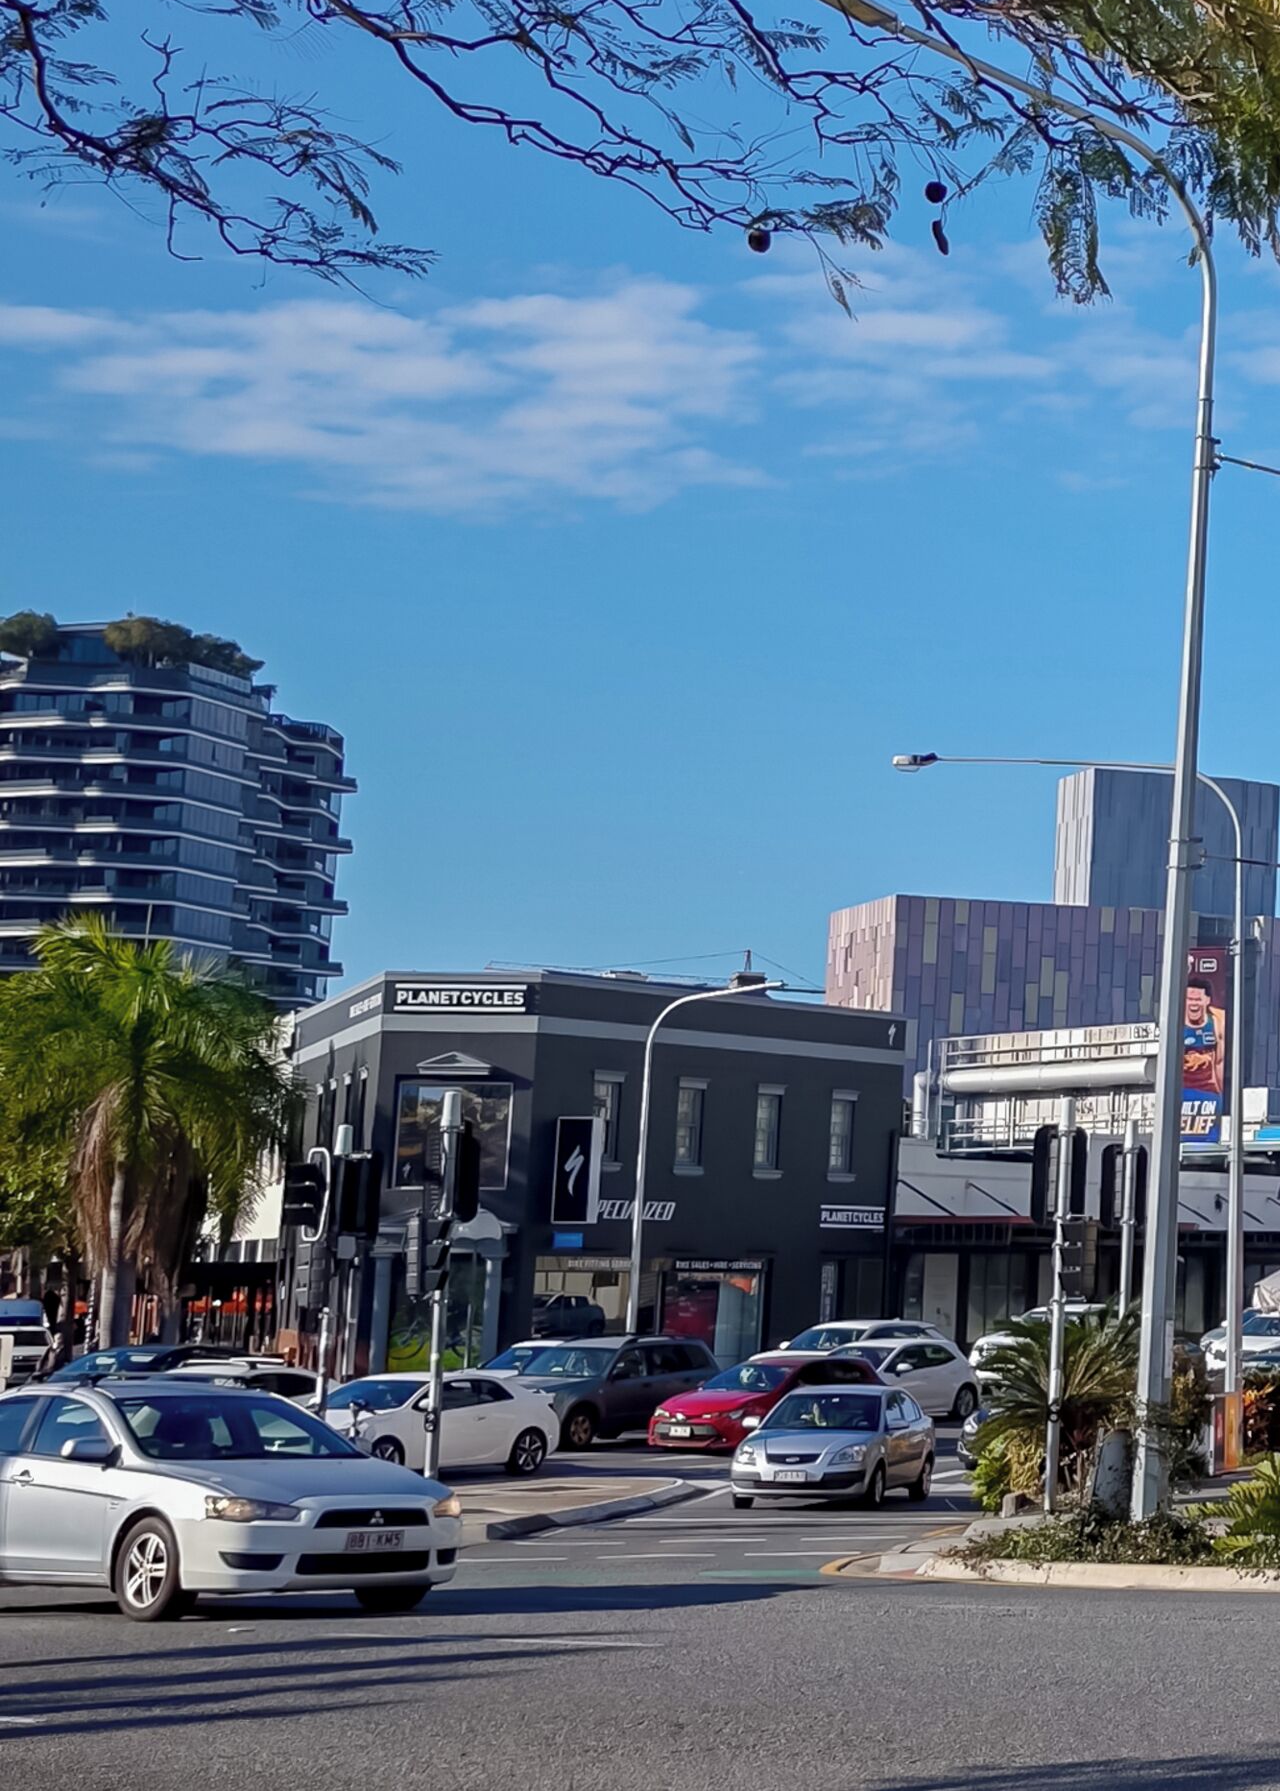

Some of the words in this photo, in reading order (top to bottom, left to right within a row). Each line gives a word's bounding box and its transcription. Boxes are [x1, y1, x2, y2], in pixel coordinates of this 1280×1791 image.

[396, 990, 525, 1005] PLANETCYCLES
[1180, 1115, 1217, 1135] ELIEF
[821, 1210, 884, 1224] PLANETCYCLES
